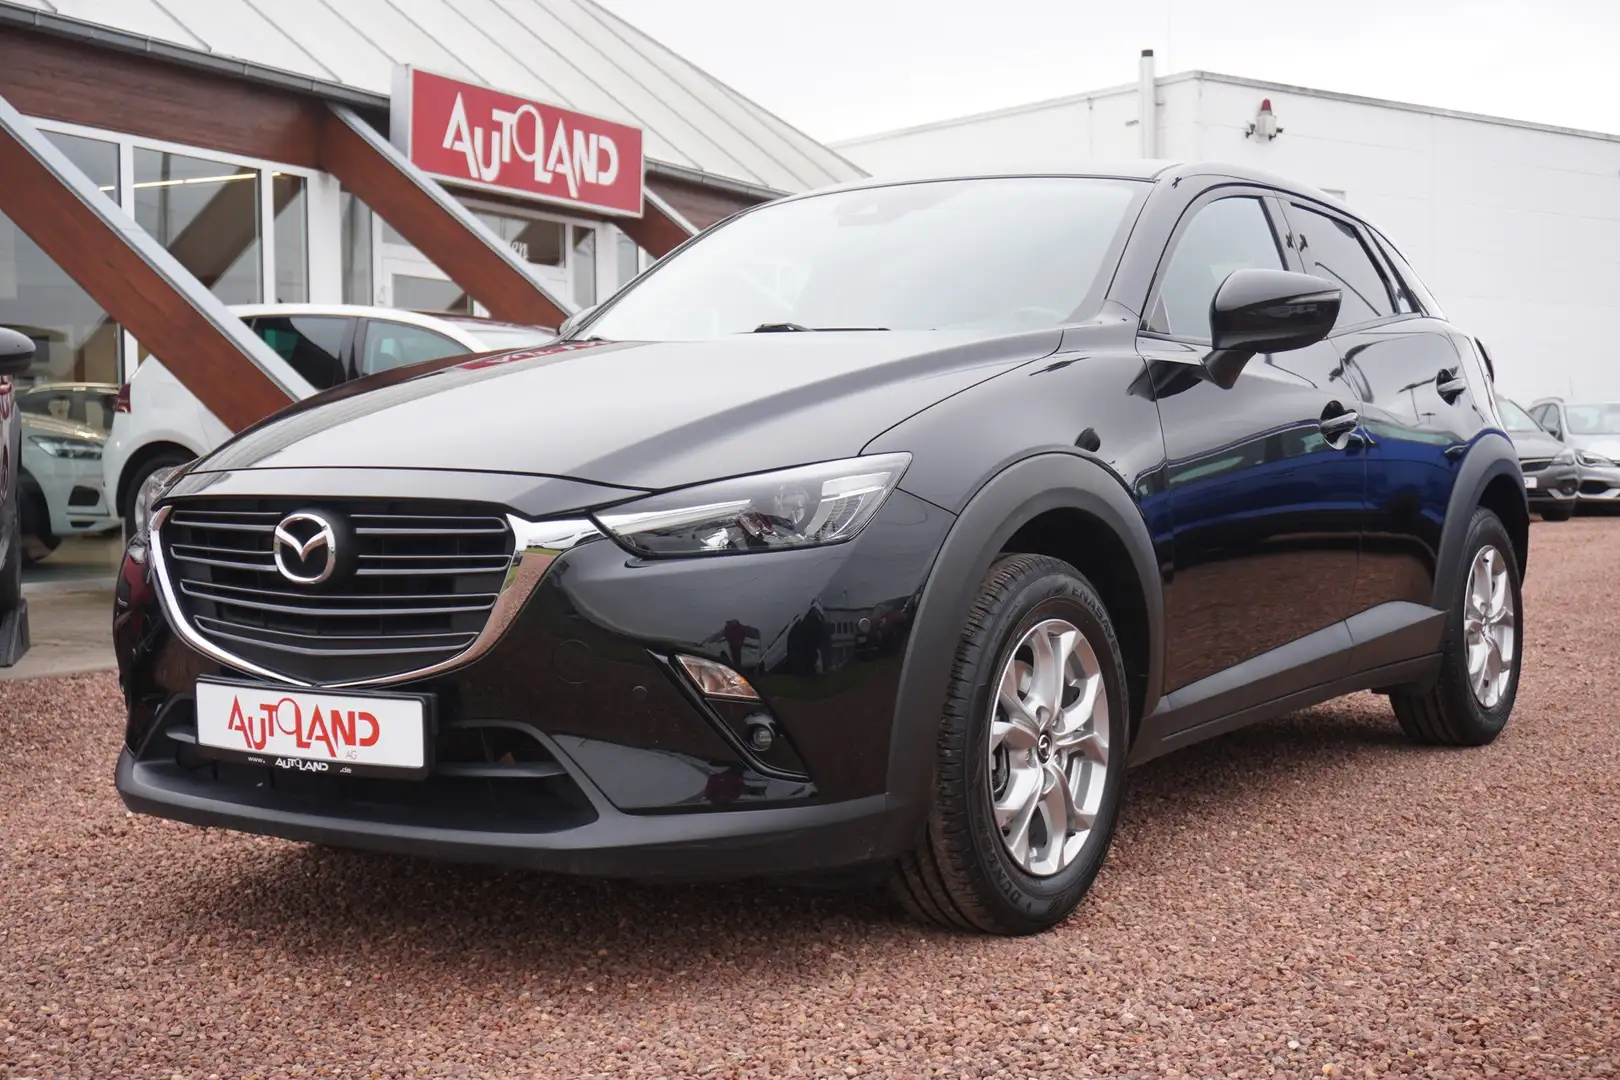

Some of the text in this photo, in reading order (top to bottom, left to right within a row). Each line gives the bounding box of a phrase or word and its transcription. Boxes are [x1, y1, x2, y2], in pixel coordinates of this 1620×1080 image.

[442, 92, 618, 198] AUTOLAND
[228, 695, 379, 758] AUTOLAND
[247, 756, 352, 774] www. AUTOLAND .de
[345, 750, 358, 760] AG
